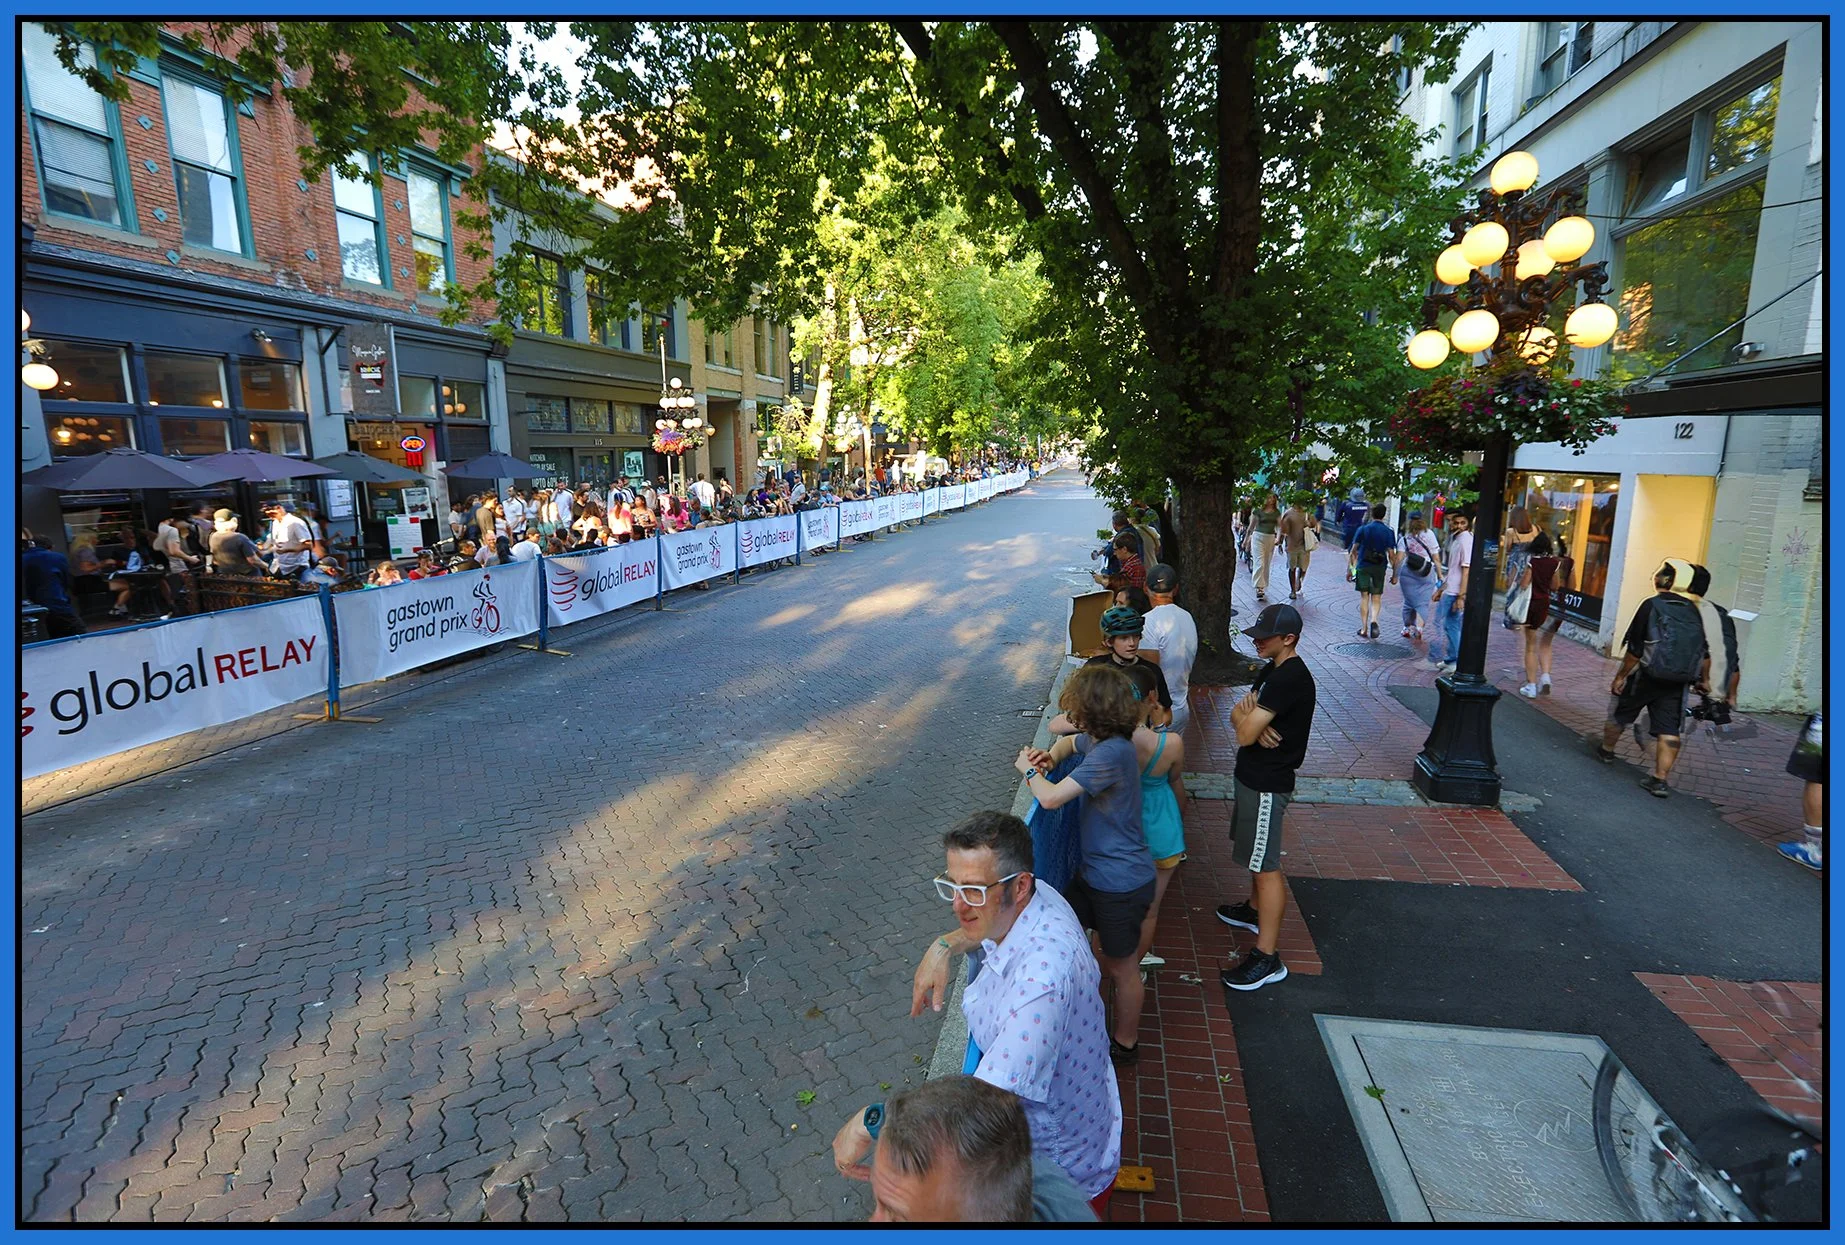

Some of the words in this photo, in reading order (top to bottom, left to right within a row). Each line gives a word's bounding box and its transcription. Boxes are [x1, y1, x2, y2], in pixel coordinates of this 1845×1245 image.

[1674, 422, 1694, 439] 122
[676, 541, 703, 559] gastown
[678, 555, 696, 574] grand
[696, 553, 709, 569] prix
[387, 596, 454, 630] gastown
[389, 616, 436, 652] grand
[441, 612, 468, 639] prix
[214, 635, 316, 684] RELAY
[1482, 1111, 1544, 1208] ELECTRICAL
